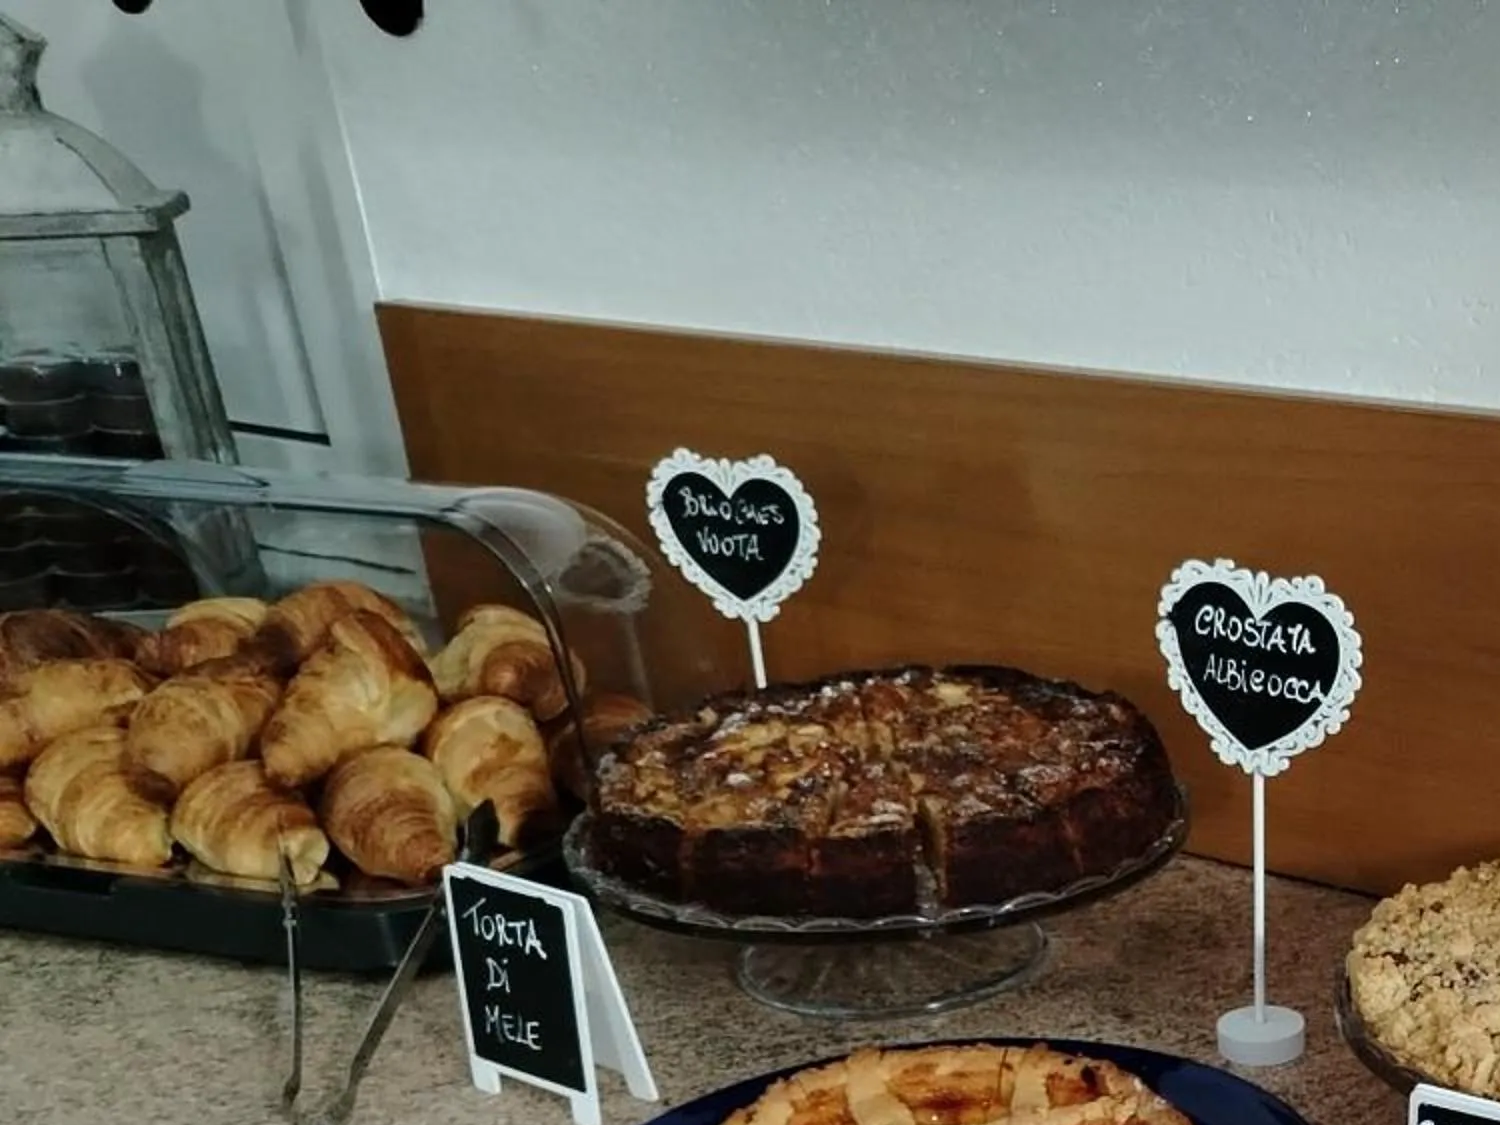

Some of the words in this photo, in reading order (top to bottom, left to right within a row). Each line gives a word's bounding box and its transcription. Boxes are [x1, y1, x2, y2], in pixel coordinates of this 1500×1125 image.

[1195, 605, 1316, 654] CROSTATA
[463, 897, 548, 960] TORTA
[485, 1004, 542, 1050] MELE
